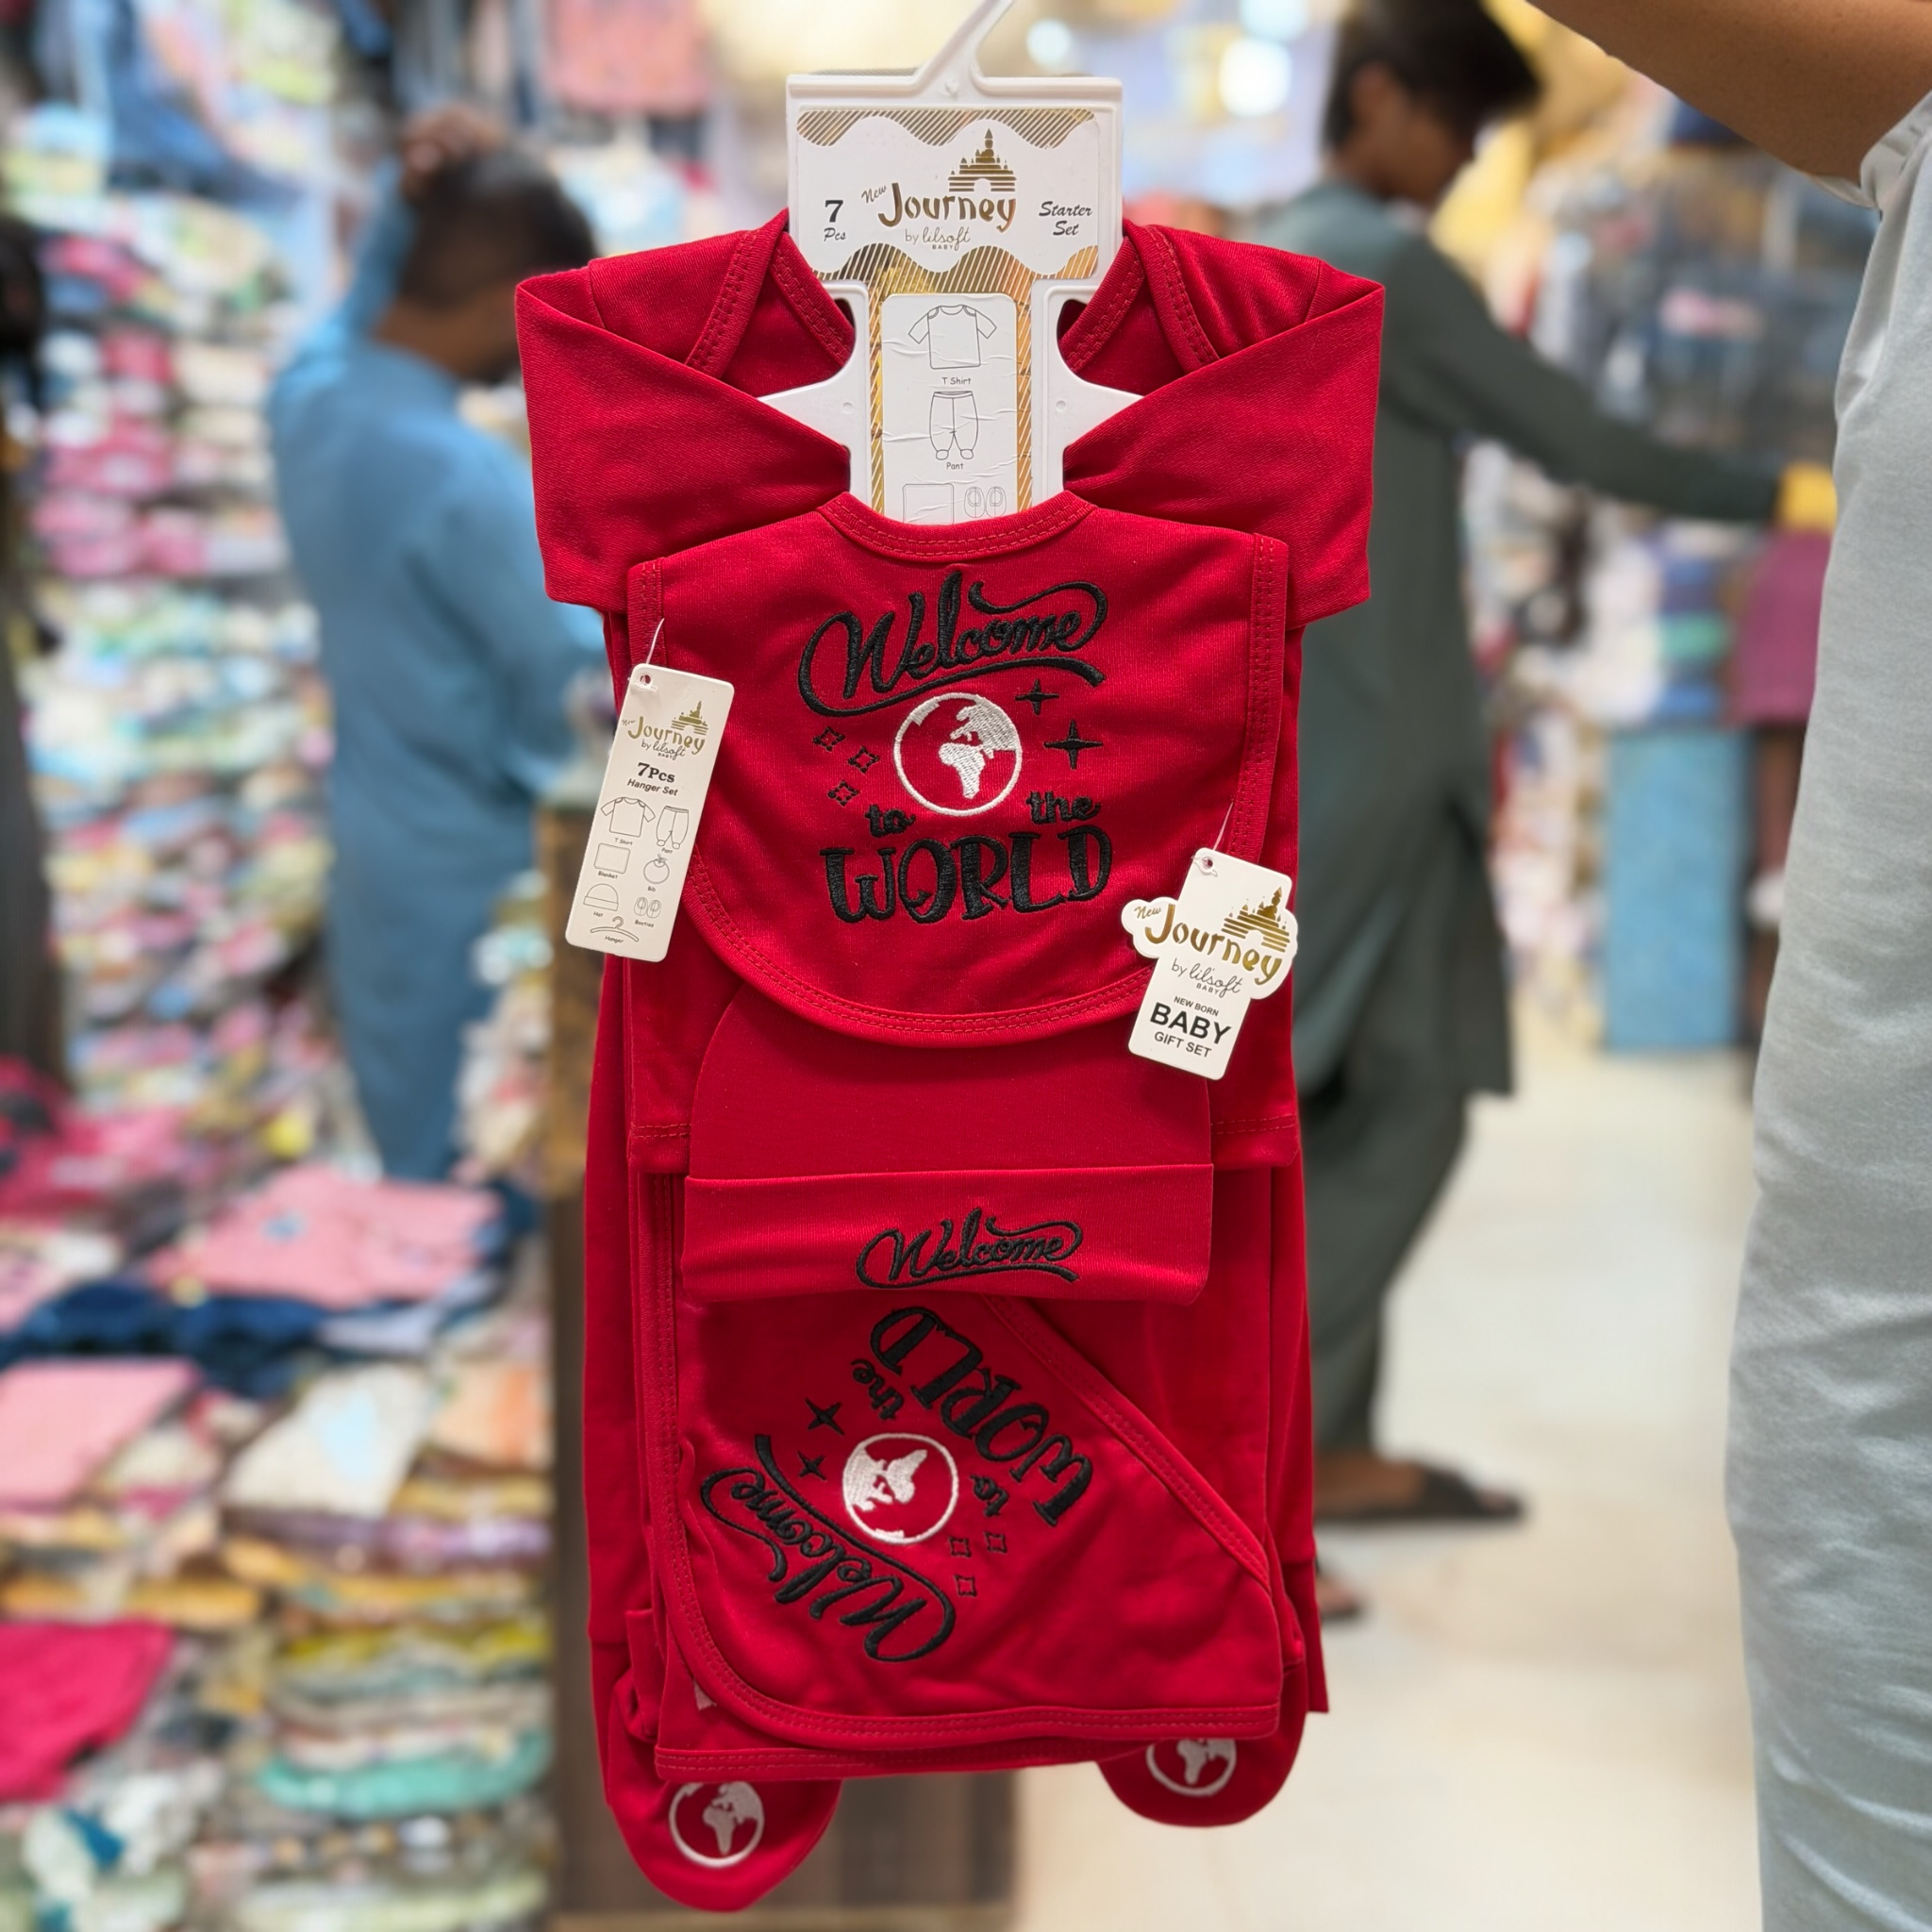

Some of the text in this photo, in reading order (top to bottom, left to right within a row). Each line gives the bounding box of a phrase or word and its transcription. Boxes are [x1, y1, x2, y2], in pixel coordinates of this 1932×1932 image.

[824, 199, 843, 223] 7
[861, 182, 1017, 233] New Journey
[1039, 201, 1092, 217] Starter
[824, 227, 846, 242] Pcs
[906, 228, 919, 245] by
[1053, 221, 1079, 236] Set
[951, 376, 972, 385] Shirt
[797, 570, 1108, 717] Welcome
[627, 716, 706, 755] Journey
[641, 739, 651, 751] by
[627, 778, 678, 796] Hanger Set
[865, 791, 1101, 838] to the
[598, 871, 618, 879] Blanket
[819, 824, 1112, 924] WORLD
[1134, 904, 1282, 986] New Journey
[1172, 958, 1188, 977] by
[1196, 983, 1220, 994] BABY
[1174, 995, 1219, 1017] NEW BORN
[1150, 1002, 1232, 1044] BABY
[1154, 1031, 1212, 1058] GIFT SET
[856, 1207, 1083, 1289] Welcome
[870, 1306, 1093, 1527] WORLD
[851, 1359, 1010, 1518] to the
[700, 1434, 956, 1663] Welcome
